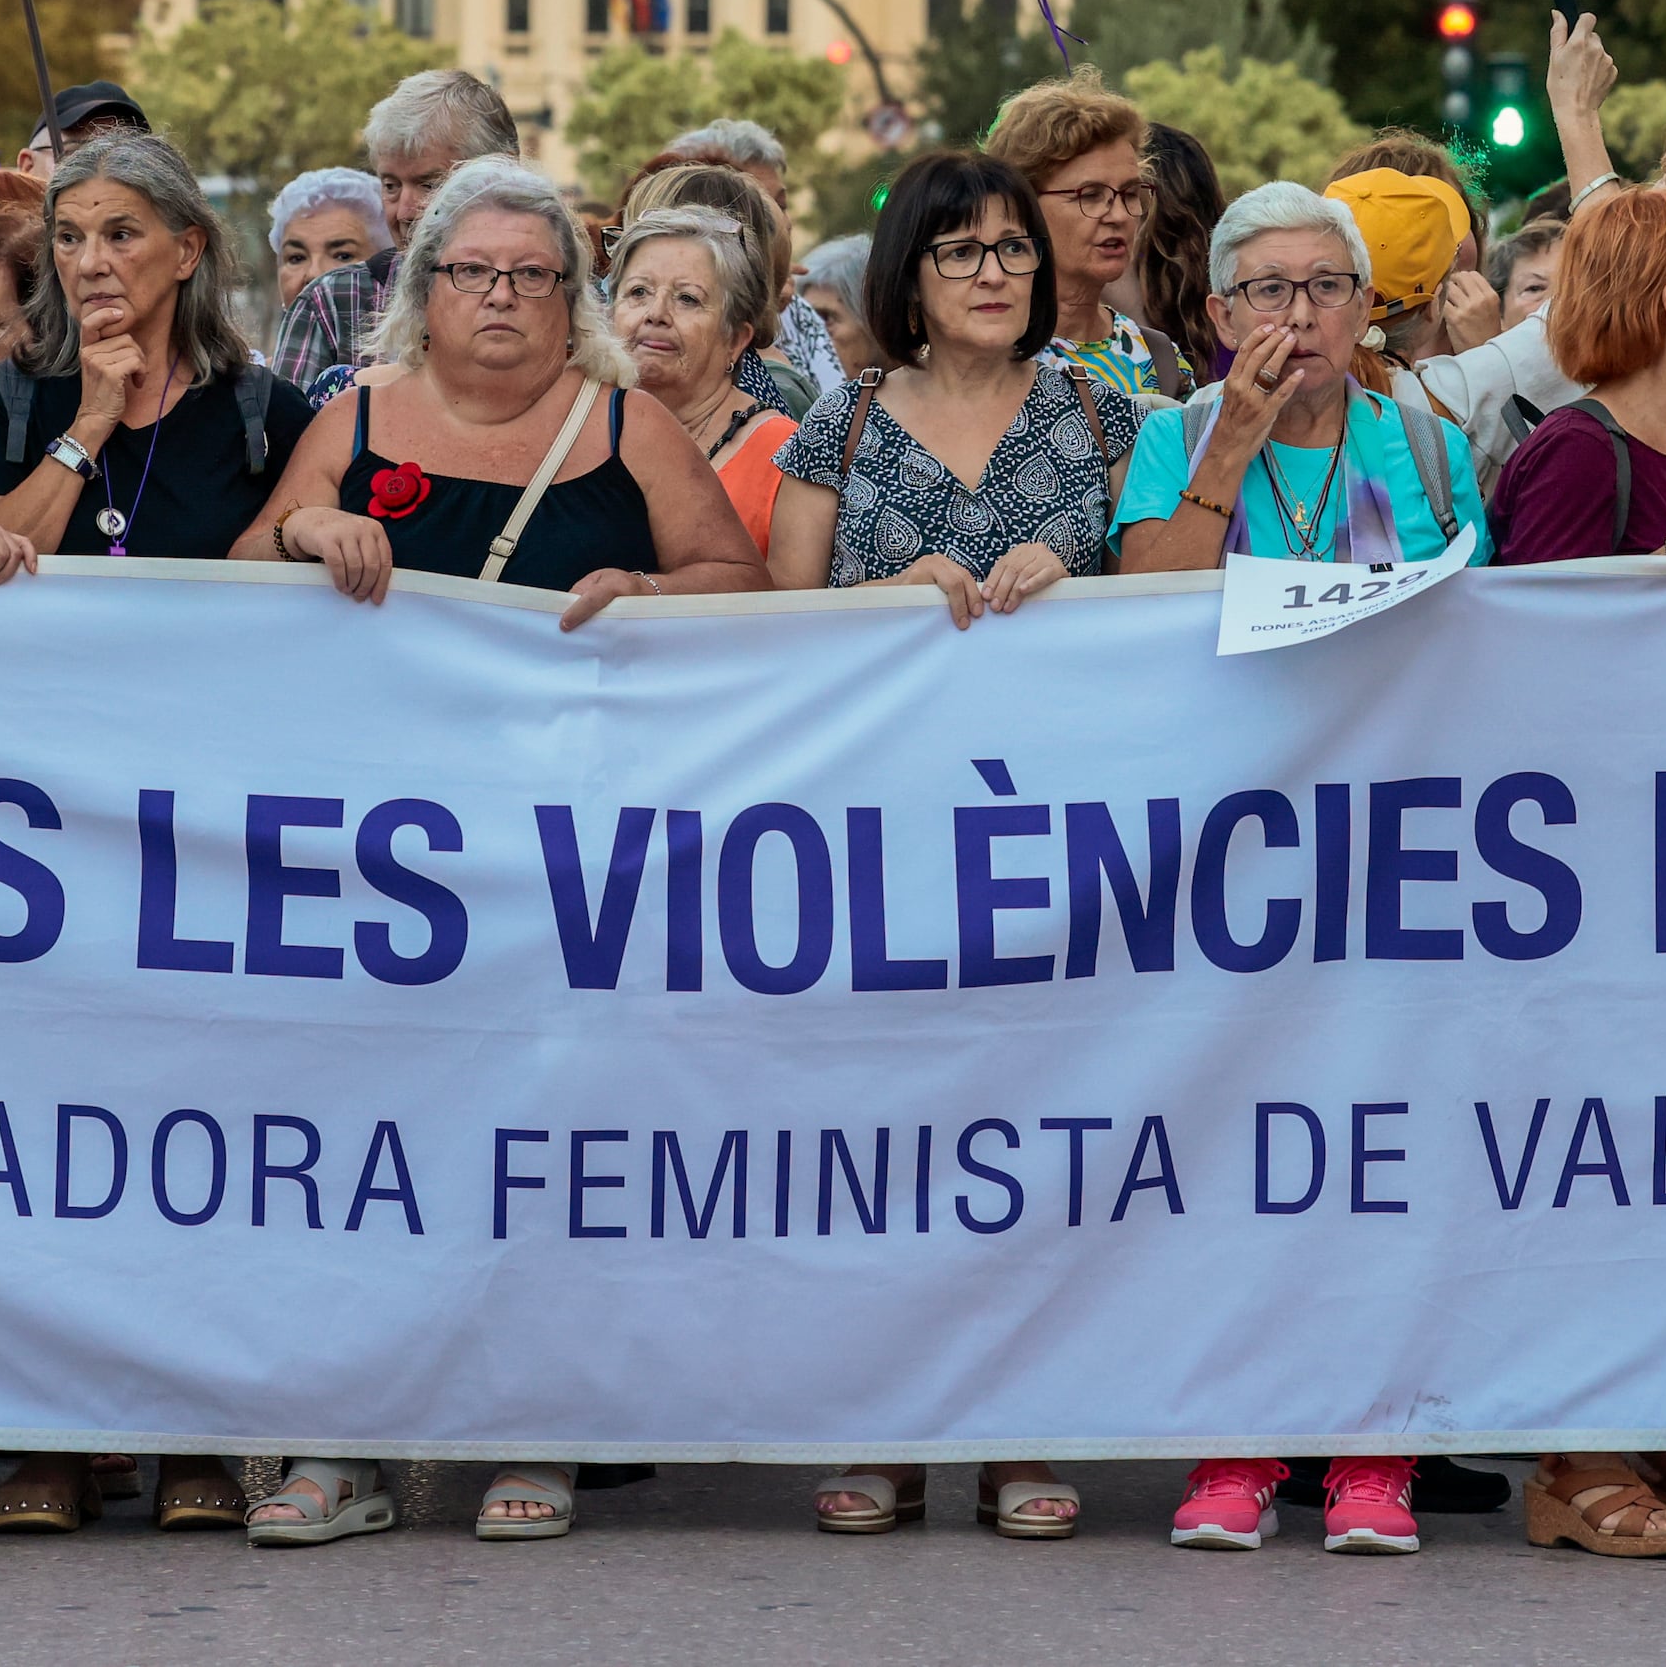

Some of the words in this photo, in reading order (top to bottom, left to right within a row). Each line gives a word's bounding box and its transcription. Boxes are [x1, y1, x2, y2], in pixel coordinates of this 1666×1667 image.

[1282, 569, 1429, 609] 1429
[1250, 621, 1304, 632] DONES
[1300, 622, 1336, 634] 2004
[135, 787, 470, 987] LES
[532, 758, 1584, 997] VIOLÈNCIES
[491, 1113, 1187, 1241] FEMINISTA
[1253, 1100, 1410, 1216] DE
